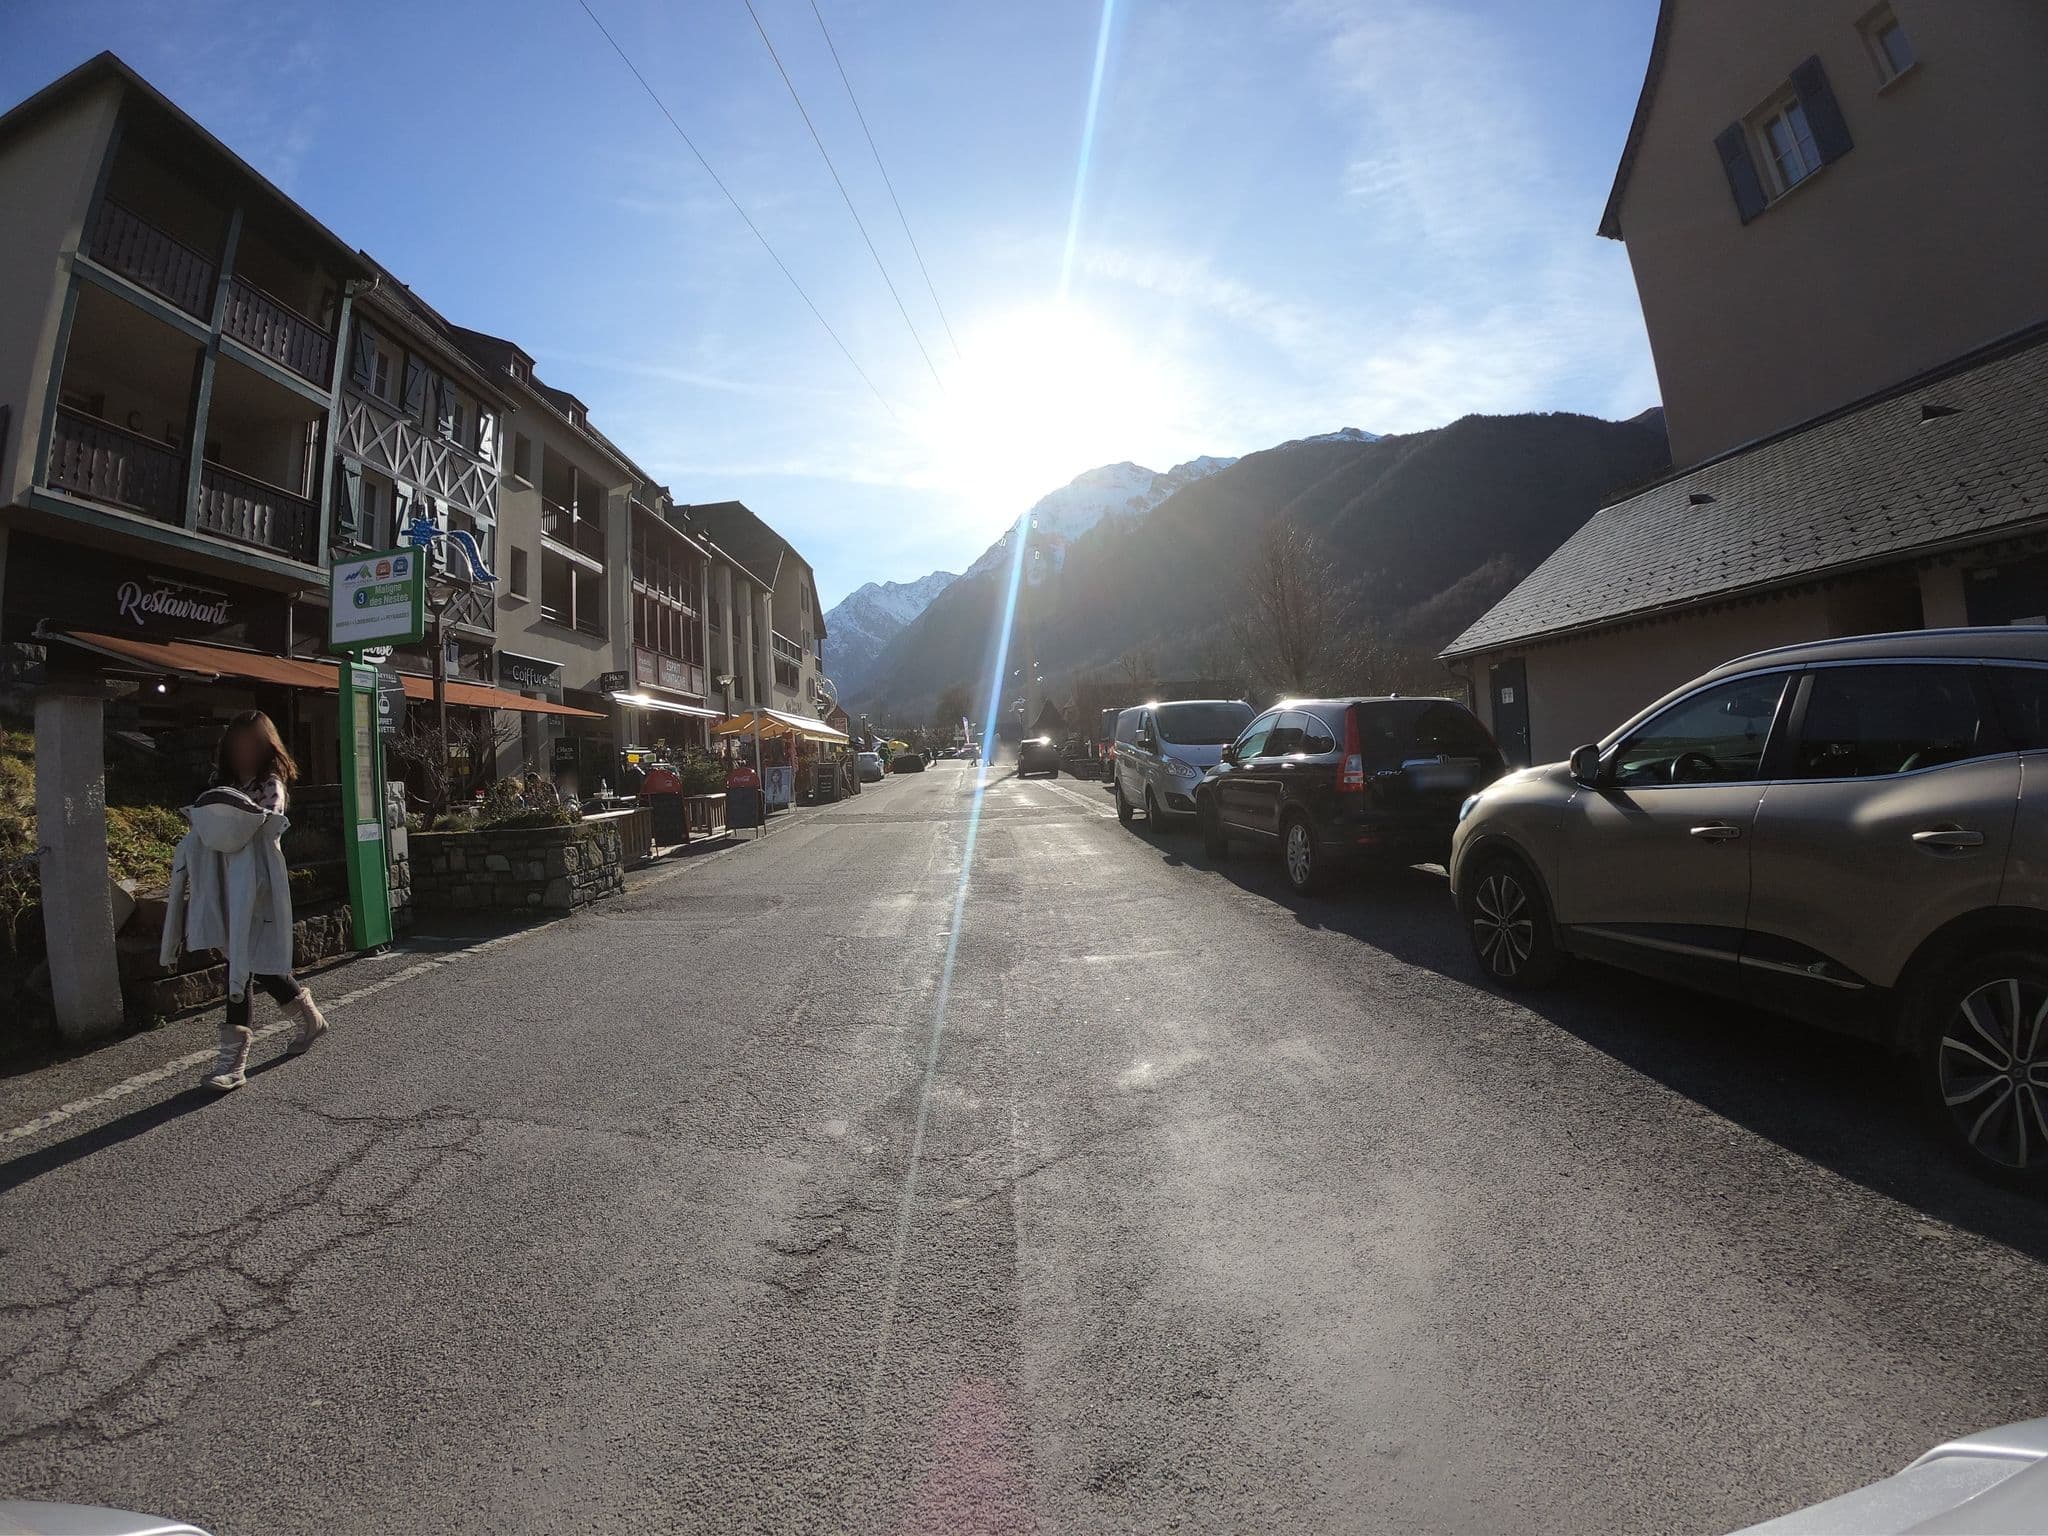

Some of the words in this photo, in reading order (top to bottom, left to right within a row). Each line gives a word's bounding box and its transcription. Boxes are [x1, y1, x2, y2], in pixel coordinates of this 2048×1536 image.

[374, 583, 402, 594] Maligne
[117, 581, 233, 625] Restaurant
[358, 592, 366, 604] 3
[512, 664, 548, 687] Coiffure
